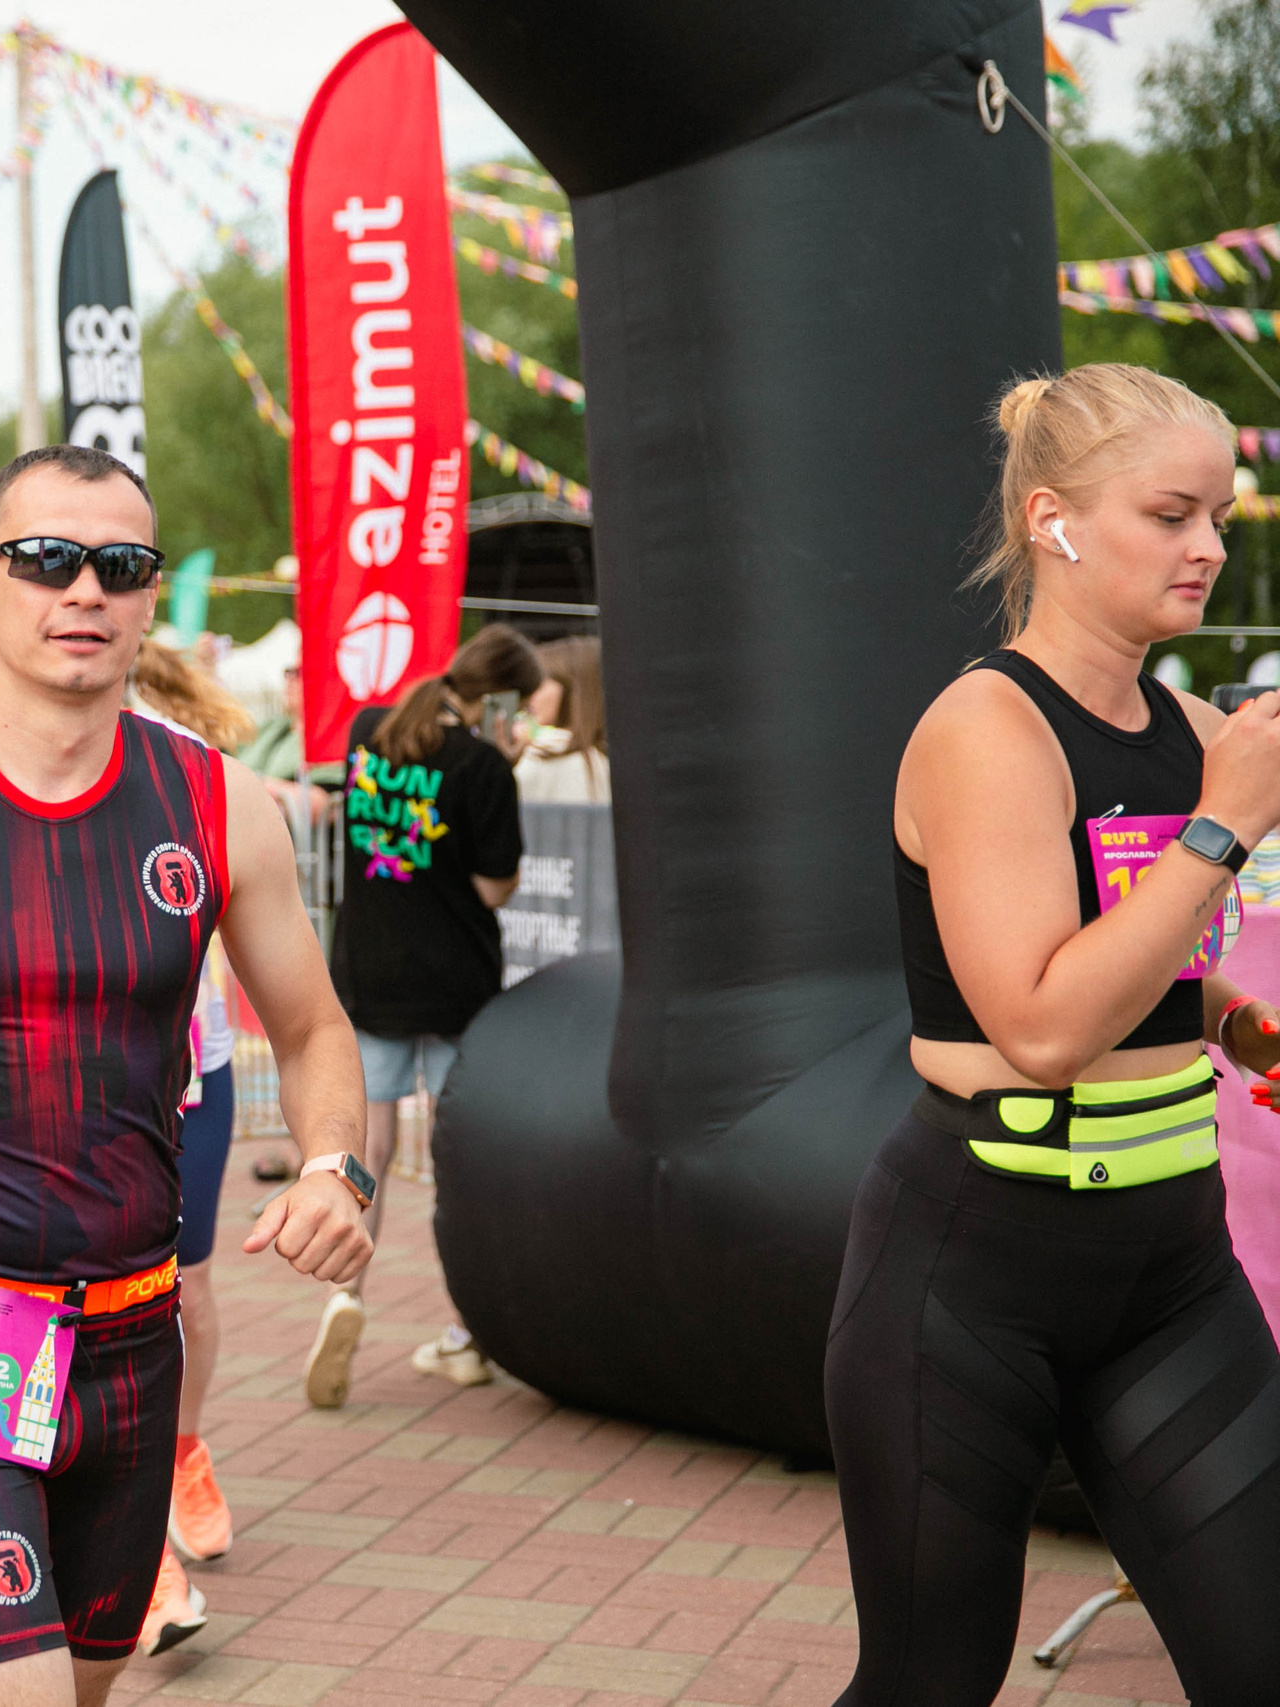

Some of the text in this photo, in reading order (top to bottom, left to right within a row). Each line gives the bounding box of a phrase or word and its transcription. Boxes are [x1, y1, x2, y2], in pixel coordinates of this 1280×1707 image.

[332, 195, 416, 568] azimut
[419, 447, 461, 565] HOTEL
[1100, 831, 1149, 846] RUTS
[1103, 851, 1156, 860] ЯРОСЛАВЛЬ
